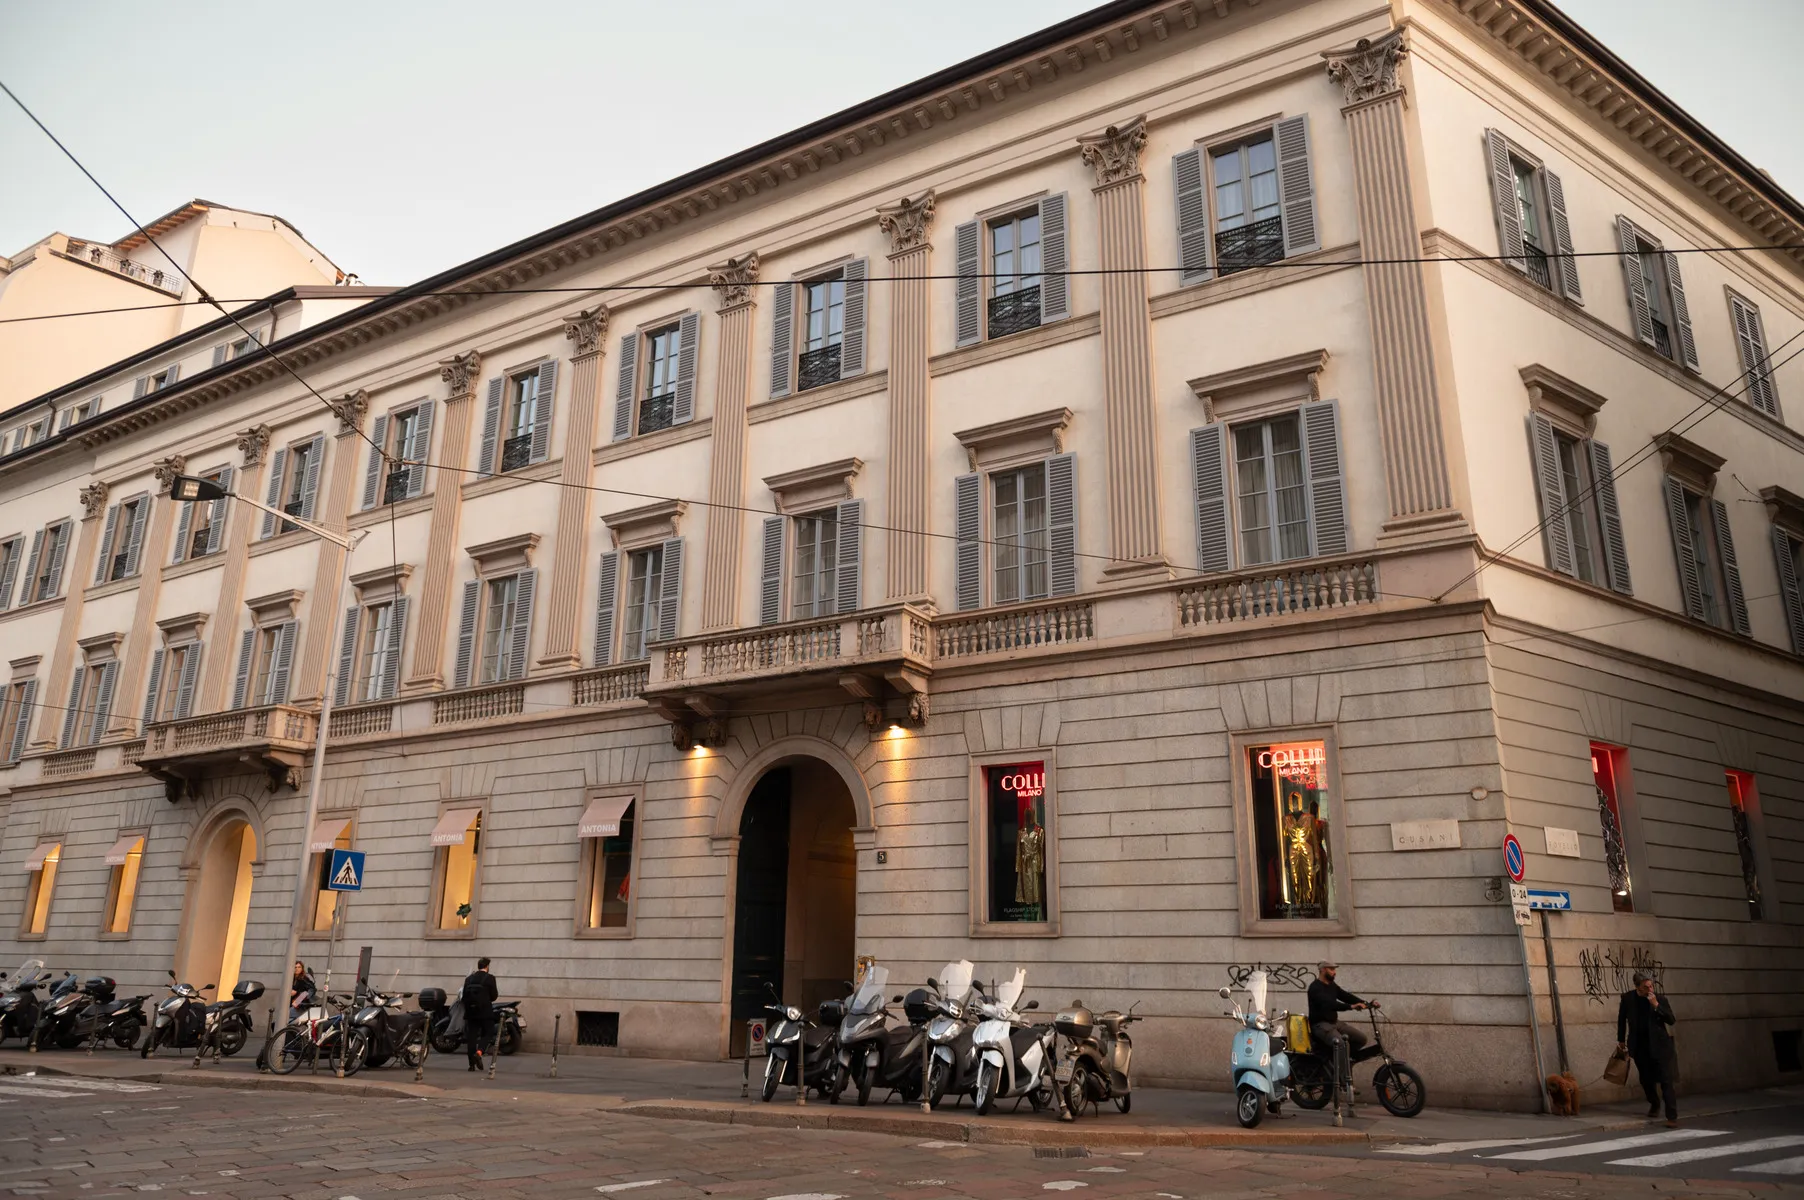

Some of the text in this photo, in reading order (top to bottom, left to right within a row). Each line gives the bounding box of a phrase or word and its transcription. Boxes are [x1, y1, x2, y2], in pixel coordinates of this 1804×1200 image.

[1279, 767, 1310, 776] MILANO
[1001, 773, 1046, 790] COLLI
[581, 823, 617, 834] ANTONIA
[432, 833, 463, 843] ANTONIA
[1399, 833, 1453, 844] CUSANI
